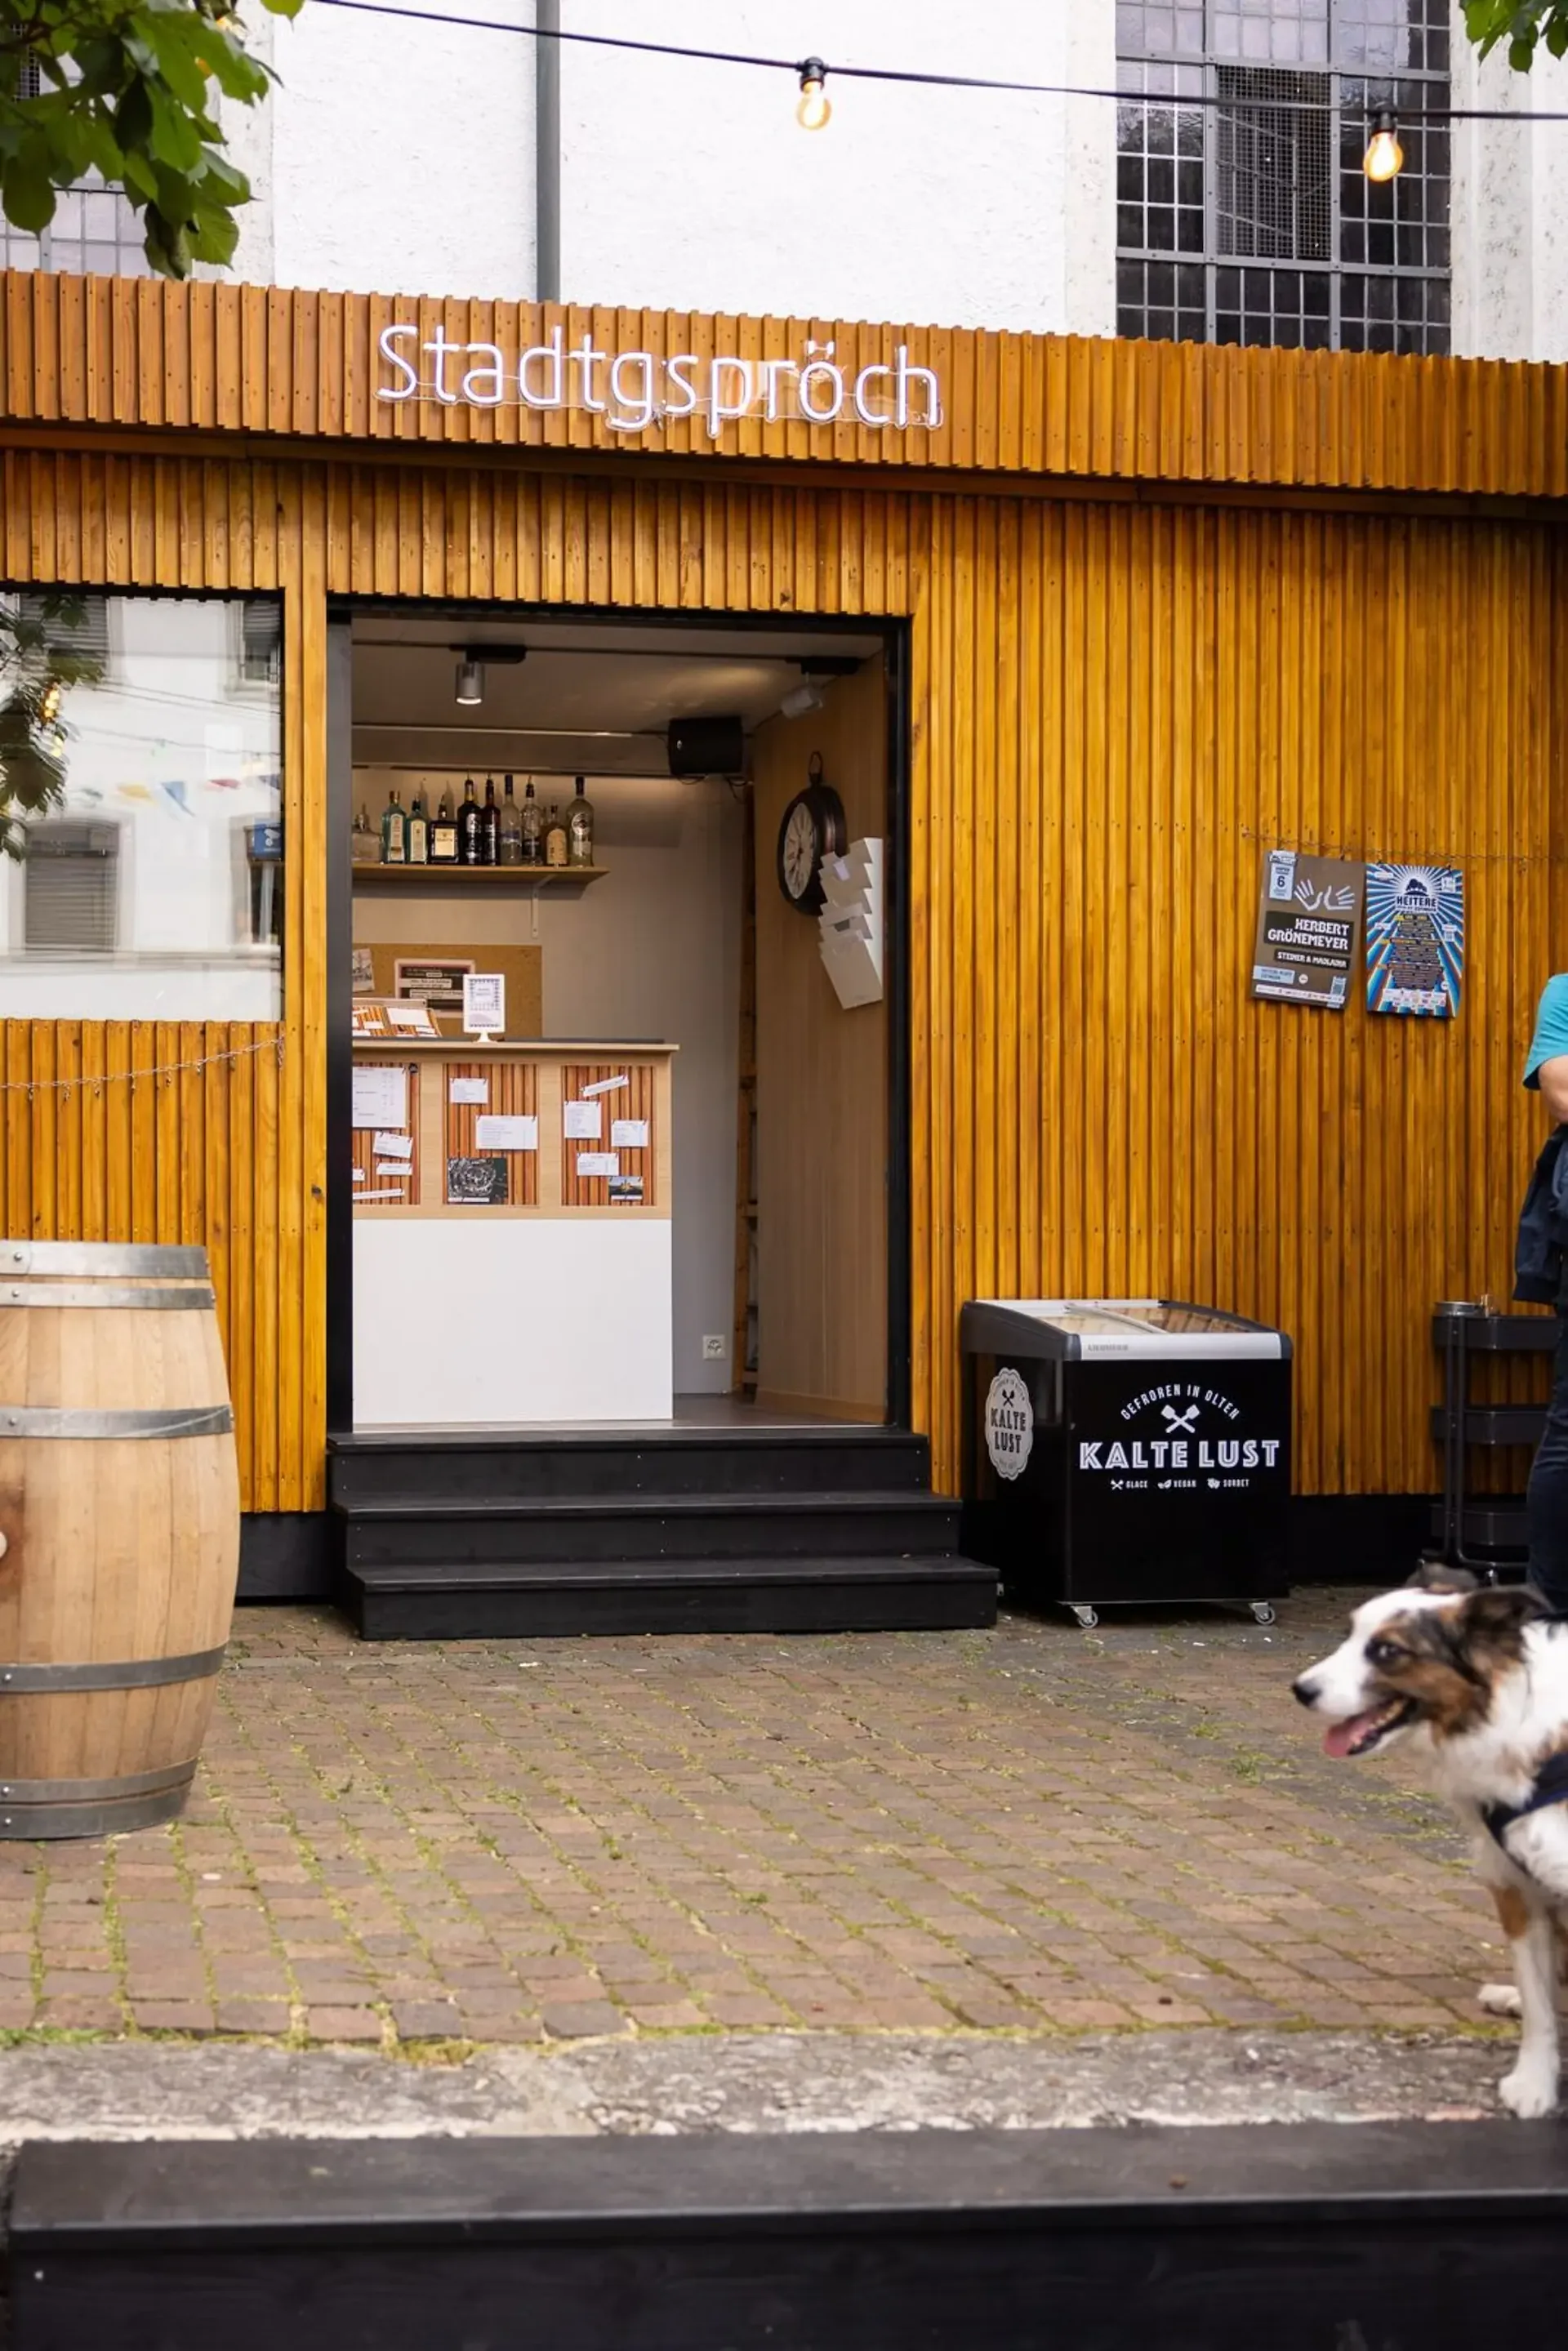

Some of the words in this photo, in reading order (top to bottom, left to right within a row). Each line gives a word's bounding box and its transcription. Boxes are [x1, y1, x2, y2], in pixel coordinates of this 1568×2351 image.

[376, 324, 940, 439] Stadtgspröch
[1276, 875, 1285, 888] 6
[1267, 928, 1348, 950] GRÖNEMEYER
[1294, 918, 1349, 936] HERBERT
[1120, 1383, 1181, 1420] GEFROREN
[1187, 1384, 1200, 1398] IN
[1204, 1389, 1241, 1420] OLTEN
[991, 1407, 1027, 1432] KALTE
[995, 1431, 1022, 1454] LUST
[1080, 1440, 1188, 1469] KALTE
[1198, 1439, 1280, 1468] LUST
